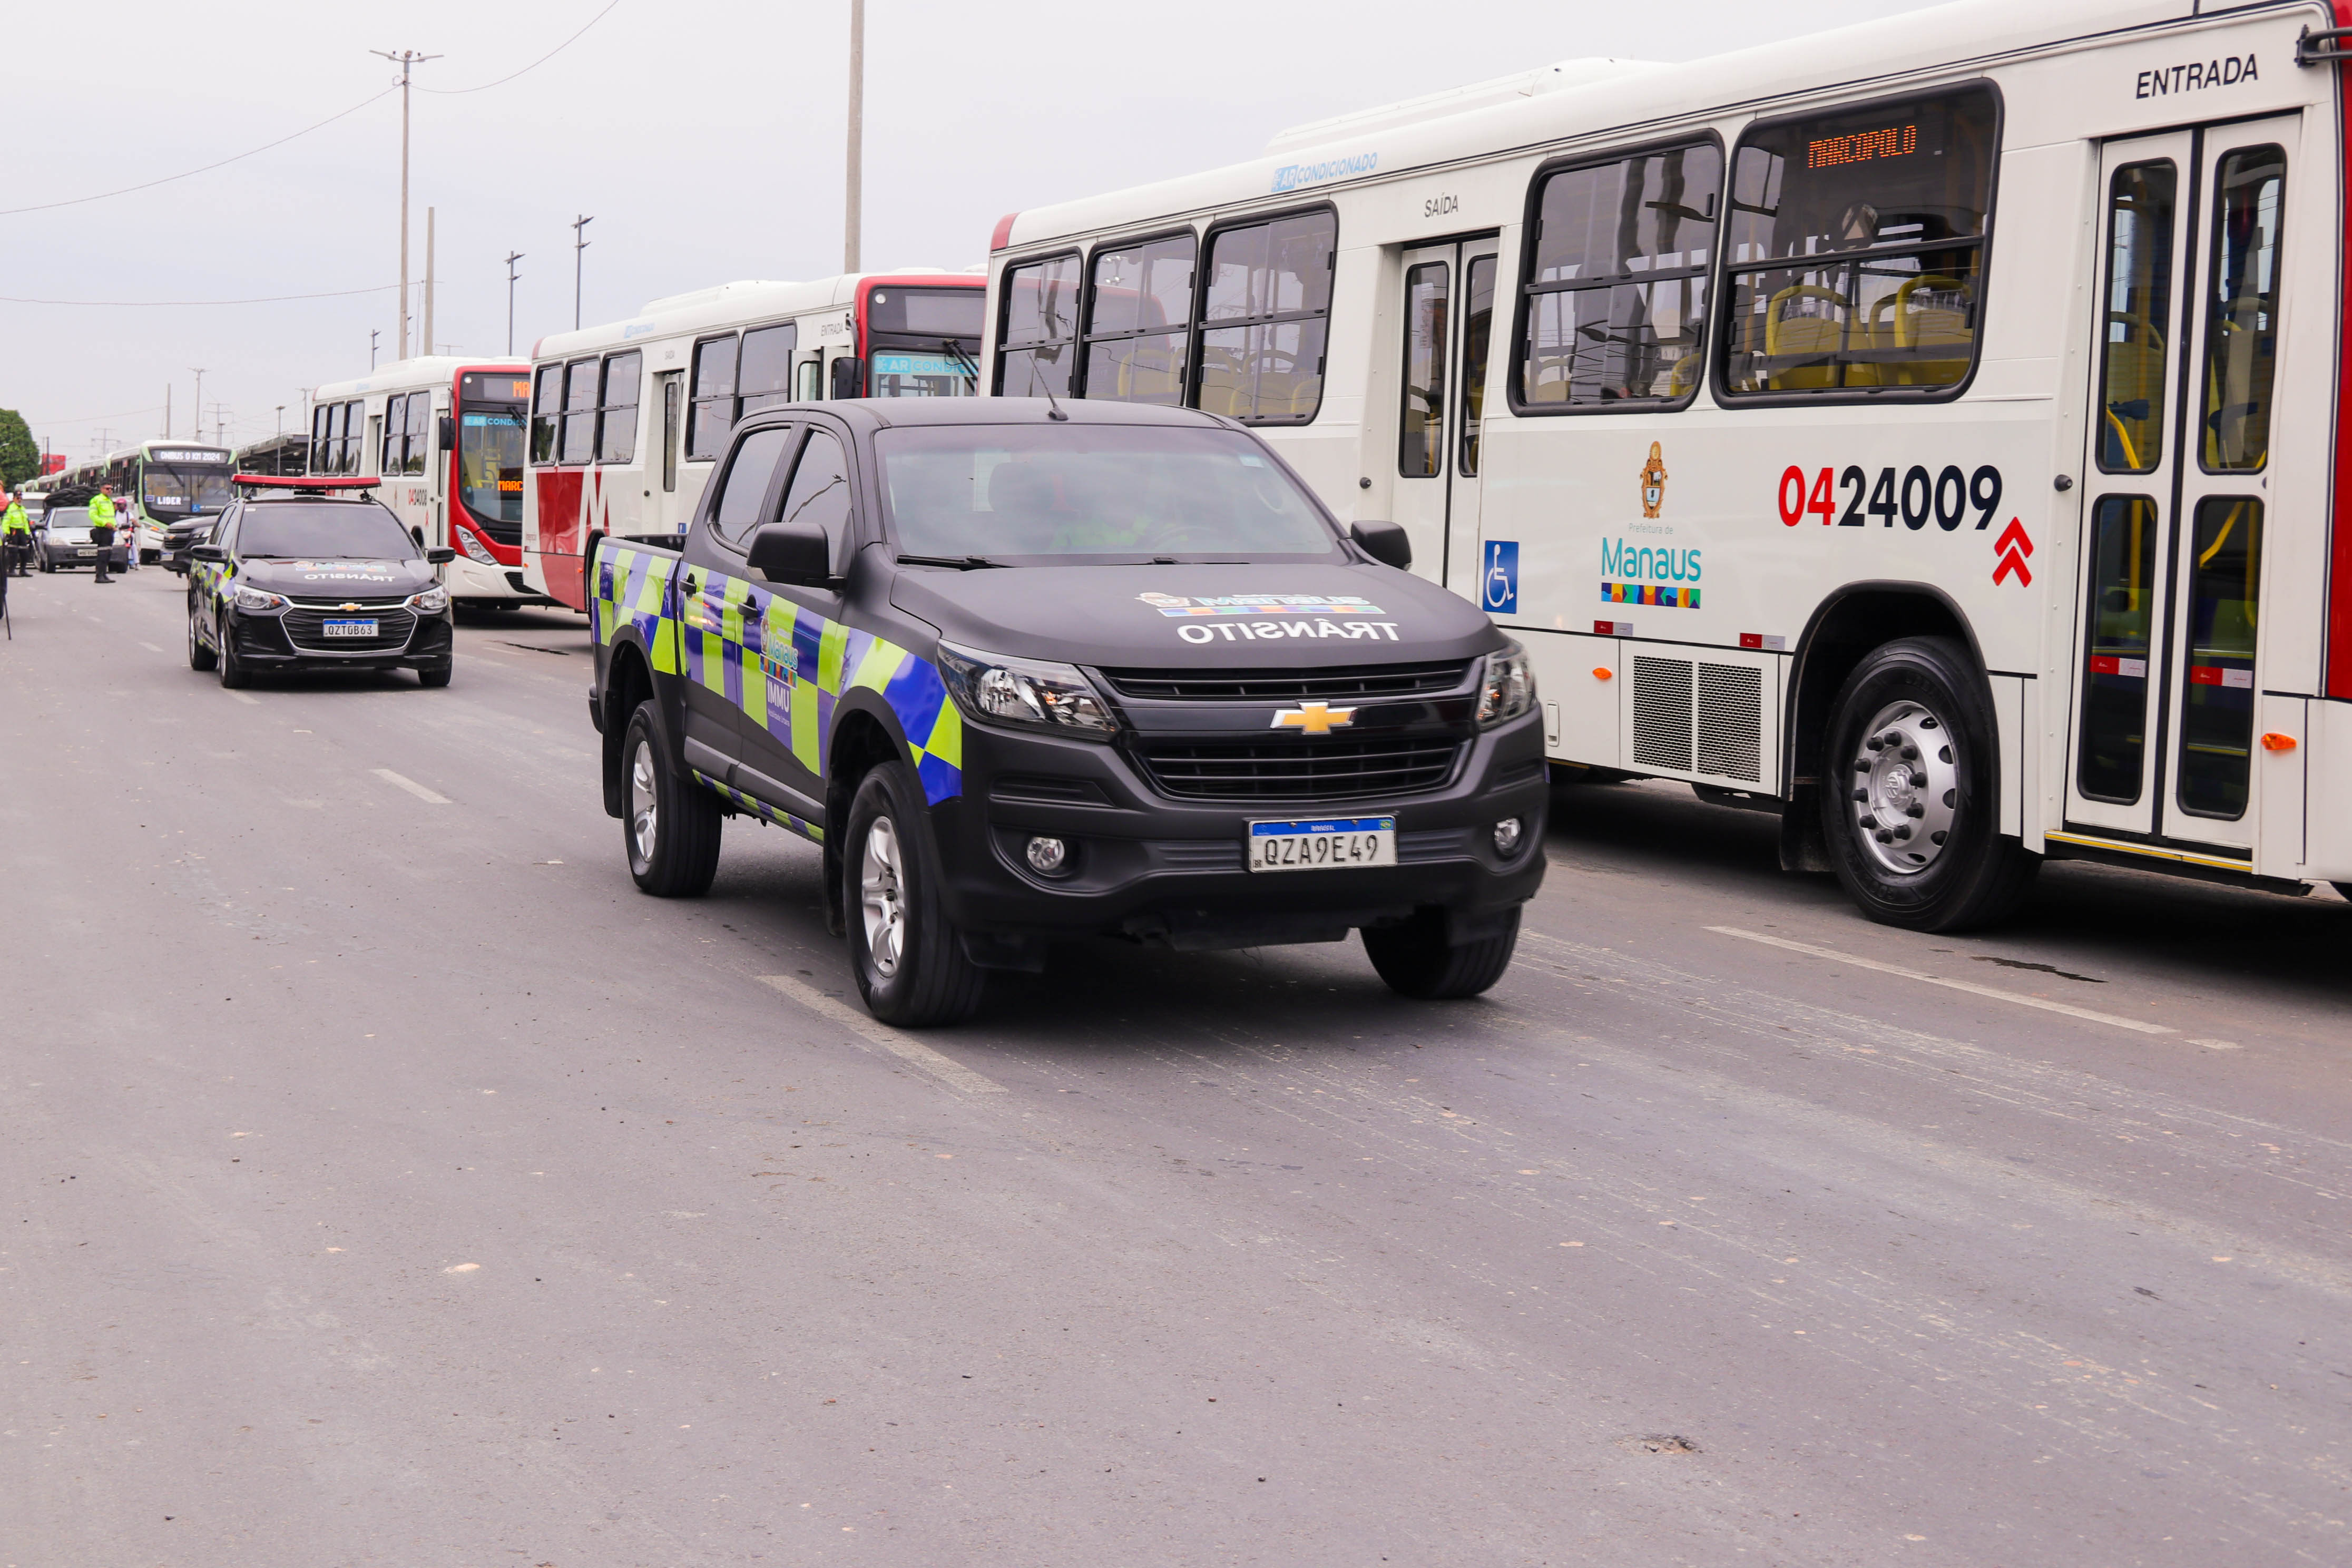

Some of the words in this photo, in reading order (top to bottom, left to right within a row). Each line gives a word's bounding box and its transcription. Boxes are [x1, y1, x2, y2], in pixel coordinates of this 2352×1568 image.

[2135, 53, 2258, 100] ENTRADA
[1808, 125, 1916, 168] MARCOPOLO
[1297, 152, 1378, 183] CONDICIONADO
[1424, 192, 1459, 218] SAÍDA
[821, 322, 843, 336] ENTRADA
[890, 360, 908, 371] AR
[158, 496, 181, 505] LIDER
[1778, 465, 2003, 531] 0424009
[1629, 523, 1662, 534] Prefeitura
[1665, 525, 1673, 534] de
[1601, 536, 1702, 582] Manaus
[768, 633, 799, 669] Manaus
[767, 680, 790, 712] IMMU
[1265, 835, 1378, 865] QZA9E49
